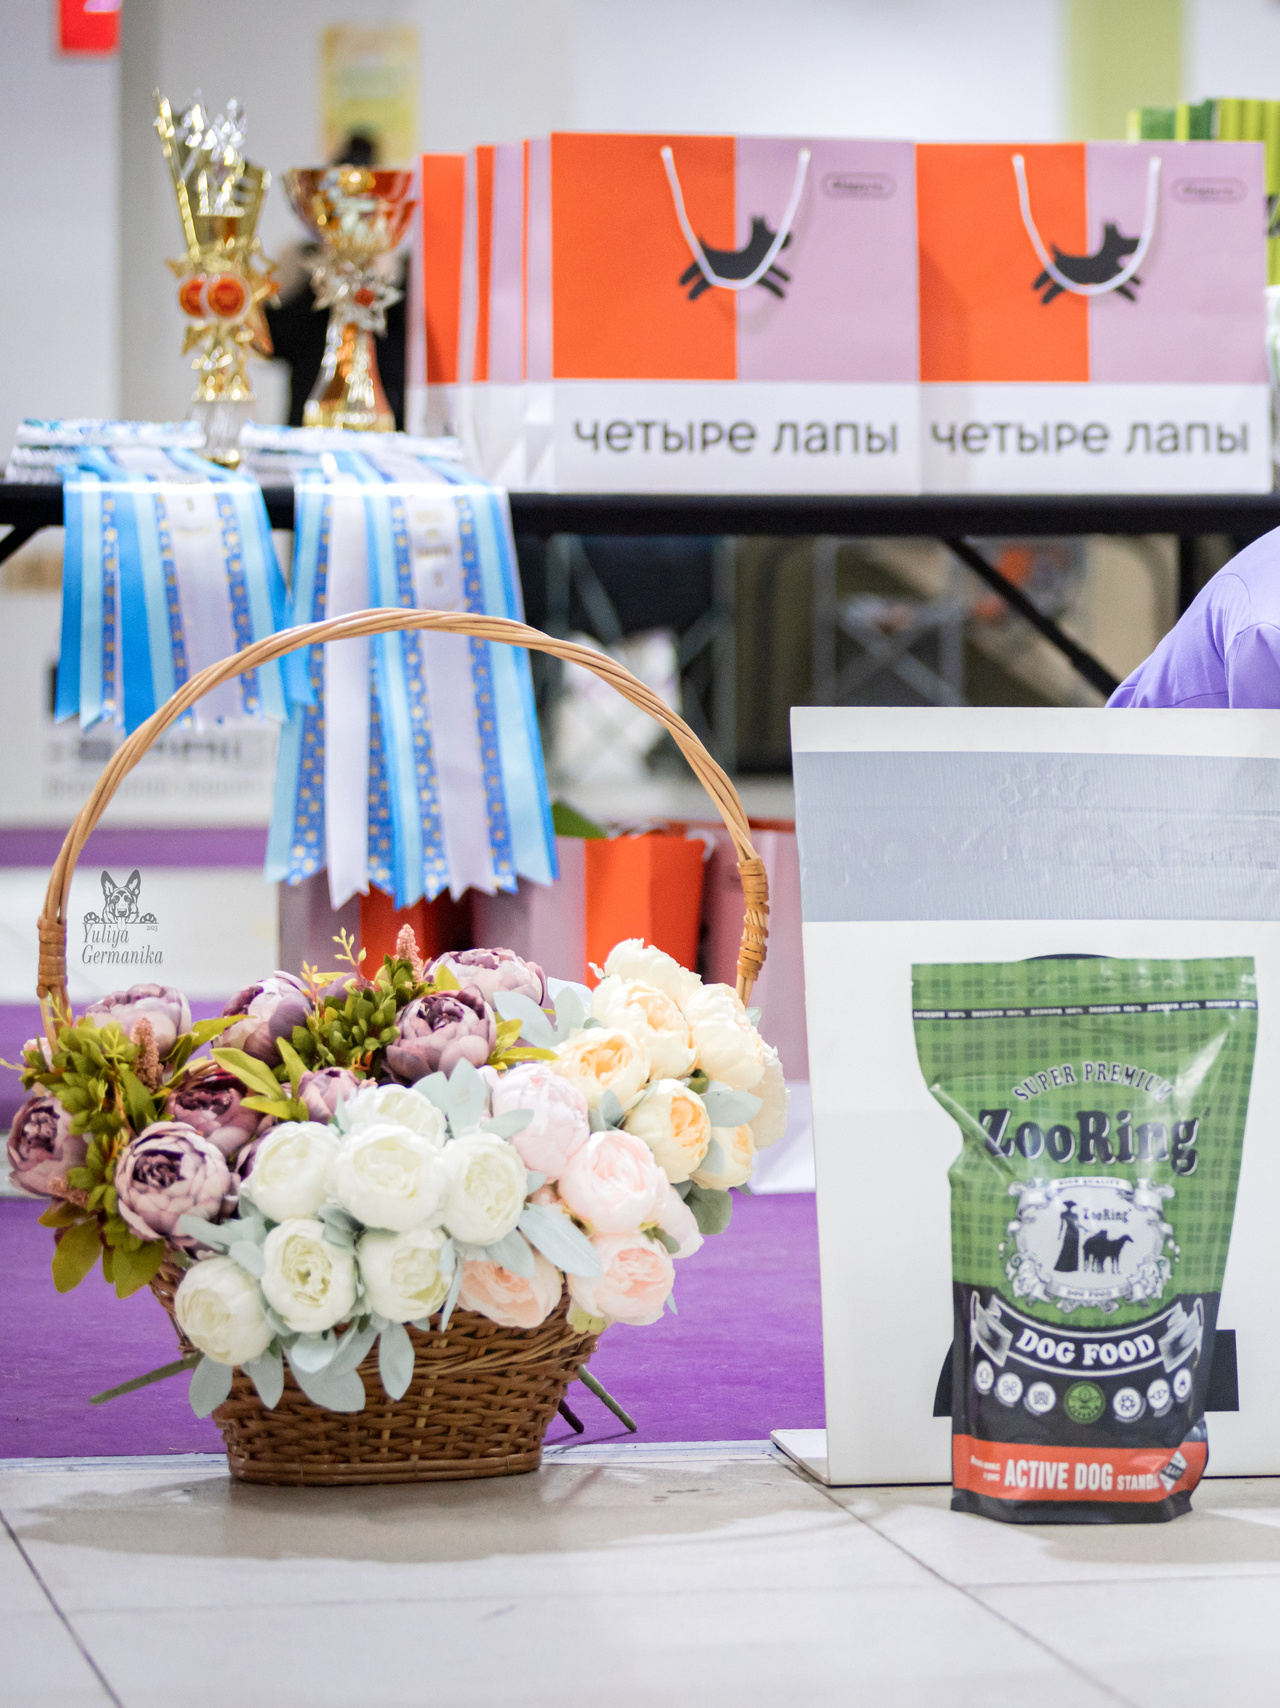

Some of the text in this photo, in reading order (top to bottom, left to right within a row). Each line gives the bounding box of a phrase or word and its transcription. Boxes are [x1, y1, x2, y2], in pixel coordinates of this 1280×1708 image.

[574, 420, 898, 454] четыре лапы
[931, 421, 1249, 454] четыре лапы
[1013, 1062, 1174, 1101] SUPER PREMIUM
[979, 1108, 1200, 1176] ZooRing
[1016, 1328, 1156, 1366] DOG FOOD
[1003, 1459, 1070, 1490] ACTIVE
[1074, 1463, 1113, 1491] DOG
